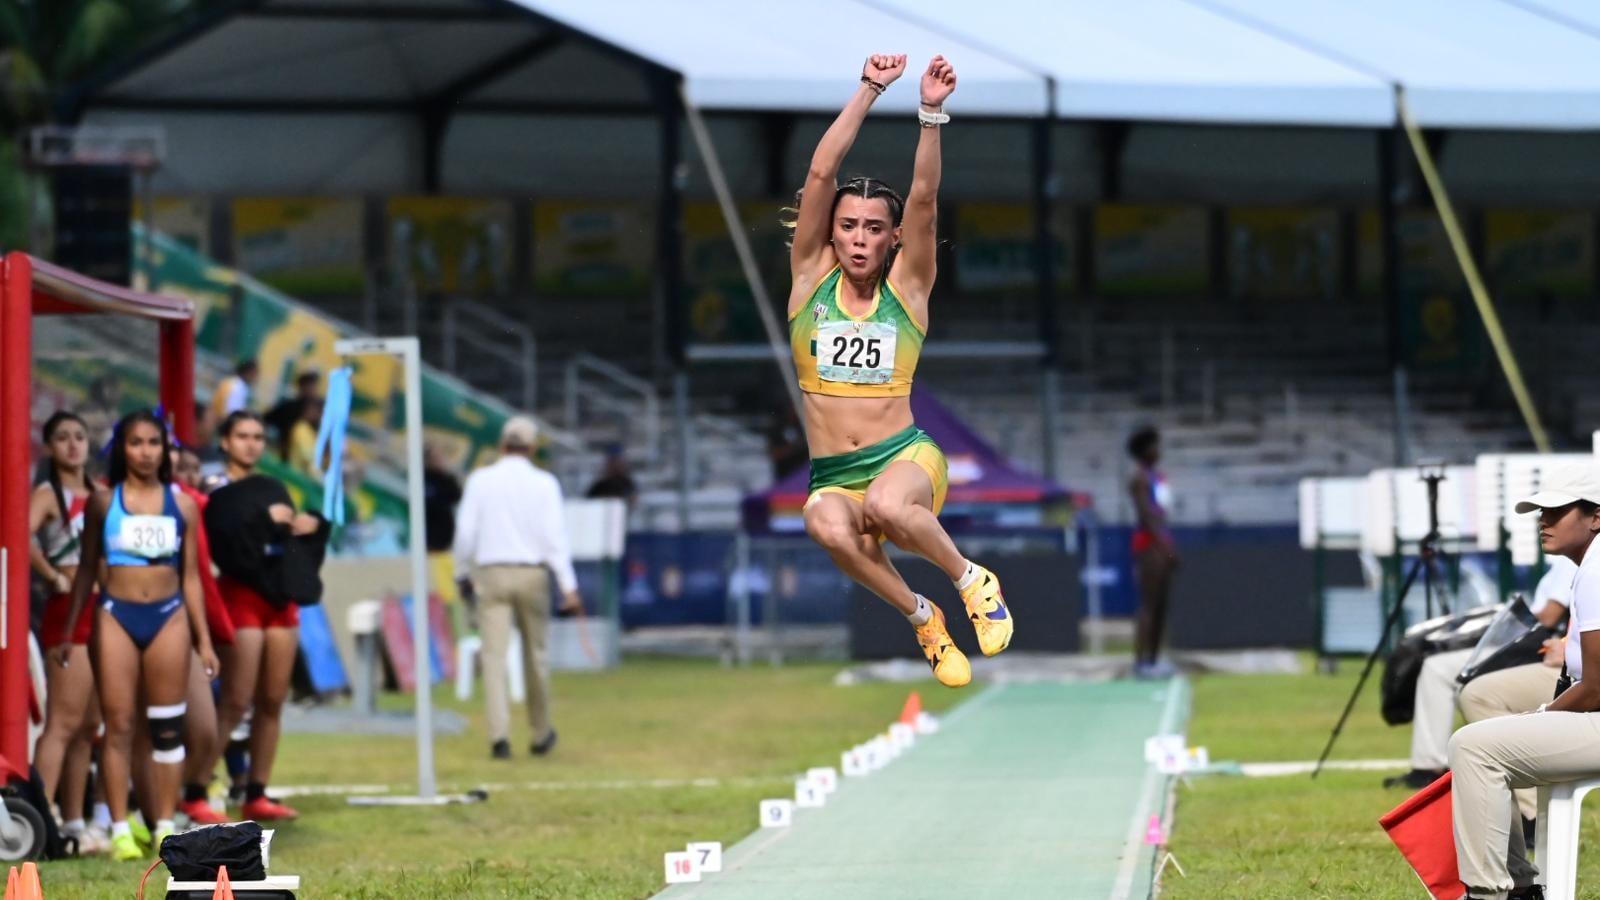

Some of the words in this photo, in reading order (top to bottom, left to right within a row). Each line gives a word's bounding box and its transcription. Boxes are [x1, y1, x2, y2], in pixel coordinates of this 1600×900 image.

[832, 336, 881, 368] 225
[133, 527, 166, 548] 320
[769, 806, 782, 821] 9
[697, 849, 711, 866] 7
